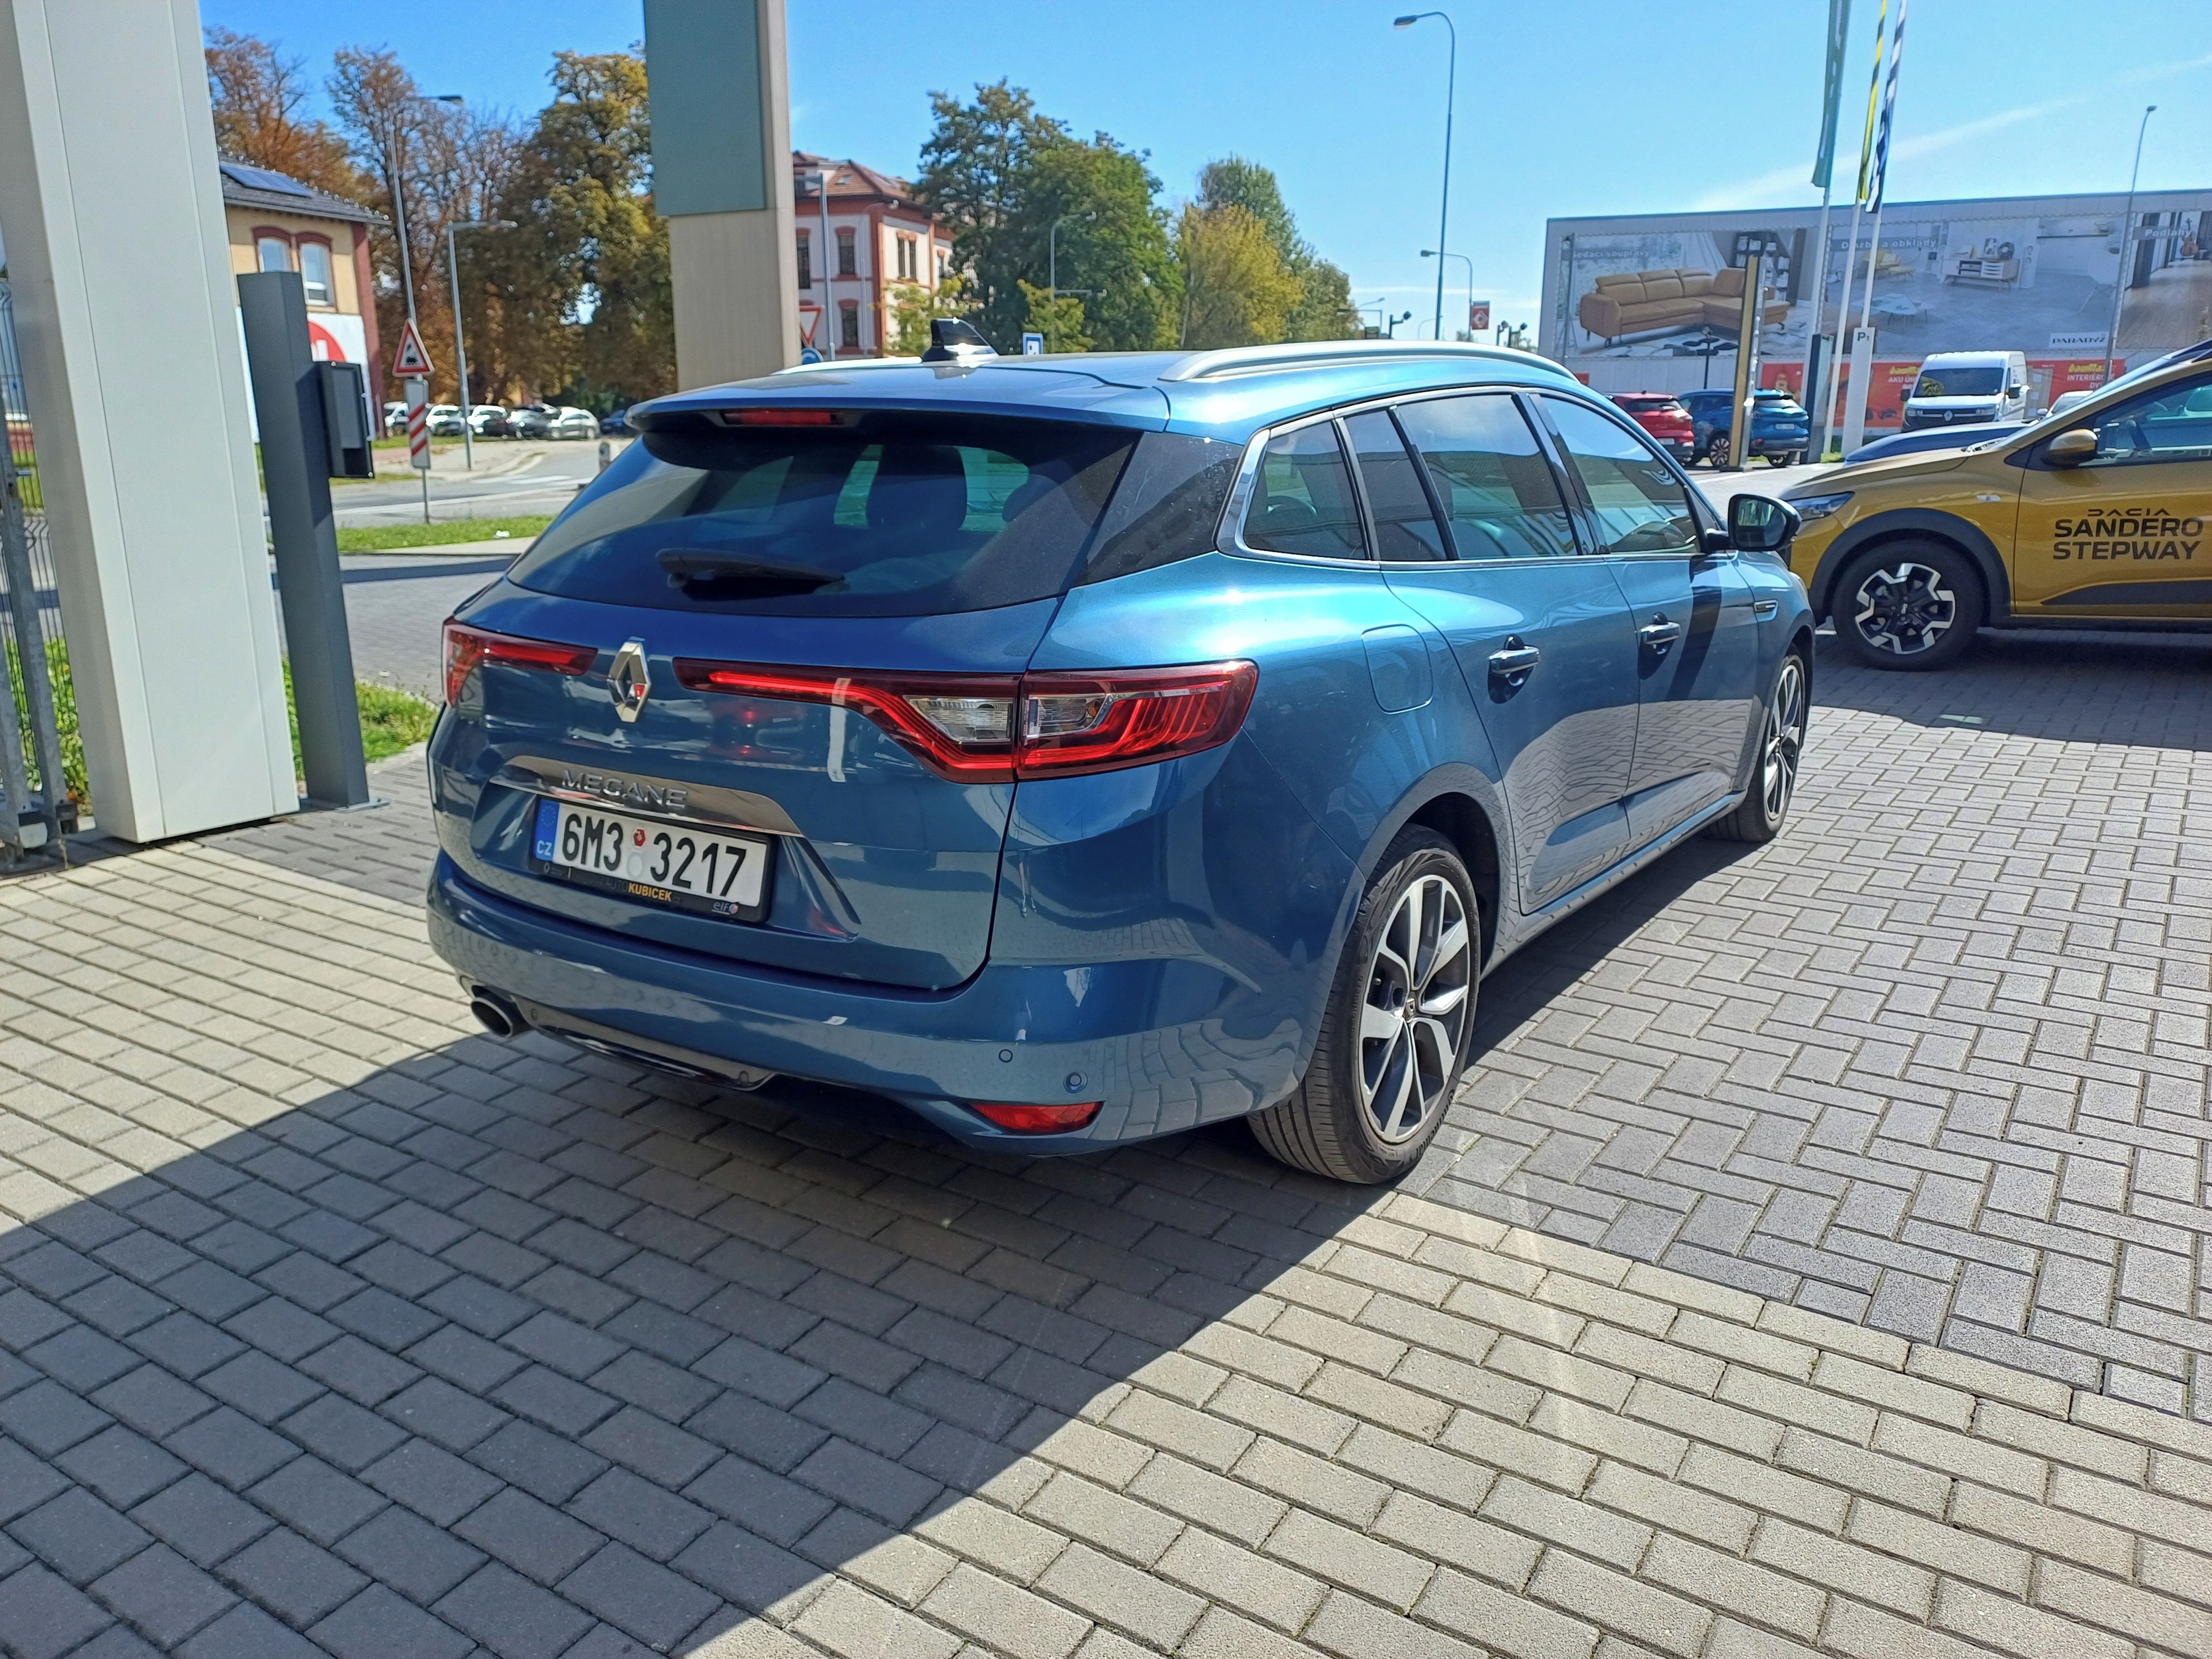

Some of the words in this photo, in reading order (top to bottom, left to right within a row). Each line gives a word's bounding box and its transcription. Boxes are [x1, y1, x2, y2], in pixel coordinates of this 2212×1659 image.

[2145, 228, 2192, 237] Podlahy
[1892, 238, 1937, 247] obklady
[2088, 508, 2171, 517] DACIA
[2054, 518, 2204, 538] SANDERO
[2053, 541, 2201, 560] STEPWAY
[562, 769, 687, 809] MEGANE
[536, 839, 551, 855] CZ
[562, 813, 623, 871] 6M3
[650, 832, 747, 897] 3217
[713, 901, 729, 912] elf
